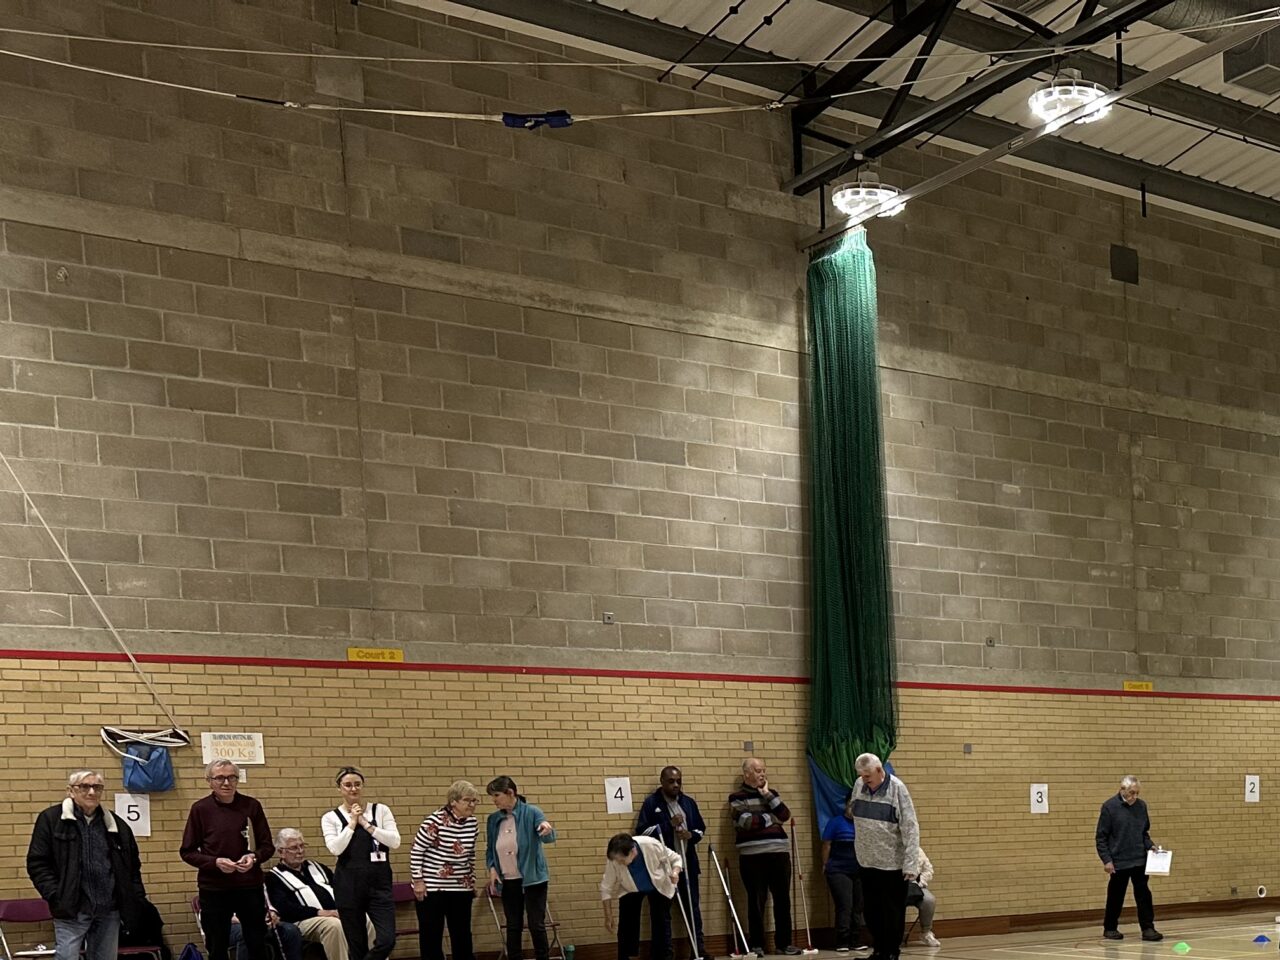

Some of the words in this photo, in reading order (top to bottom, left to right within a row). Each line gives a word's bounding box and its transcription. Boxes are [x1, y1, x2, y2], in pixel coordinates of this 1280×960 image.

[356, 649, 386, 660] Court
[213, 747, 234, 758] 300
[238, 747, 256, 760] Kg
[613, 786, 624, 801] 4
[1249, 781, 1256, 793] 2
[1036, 791, 1044, 804] 3
[127, 804, 140, 822] 5
